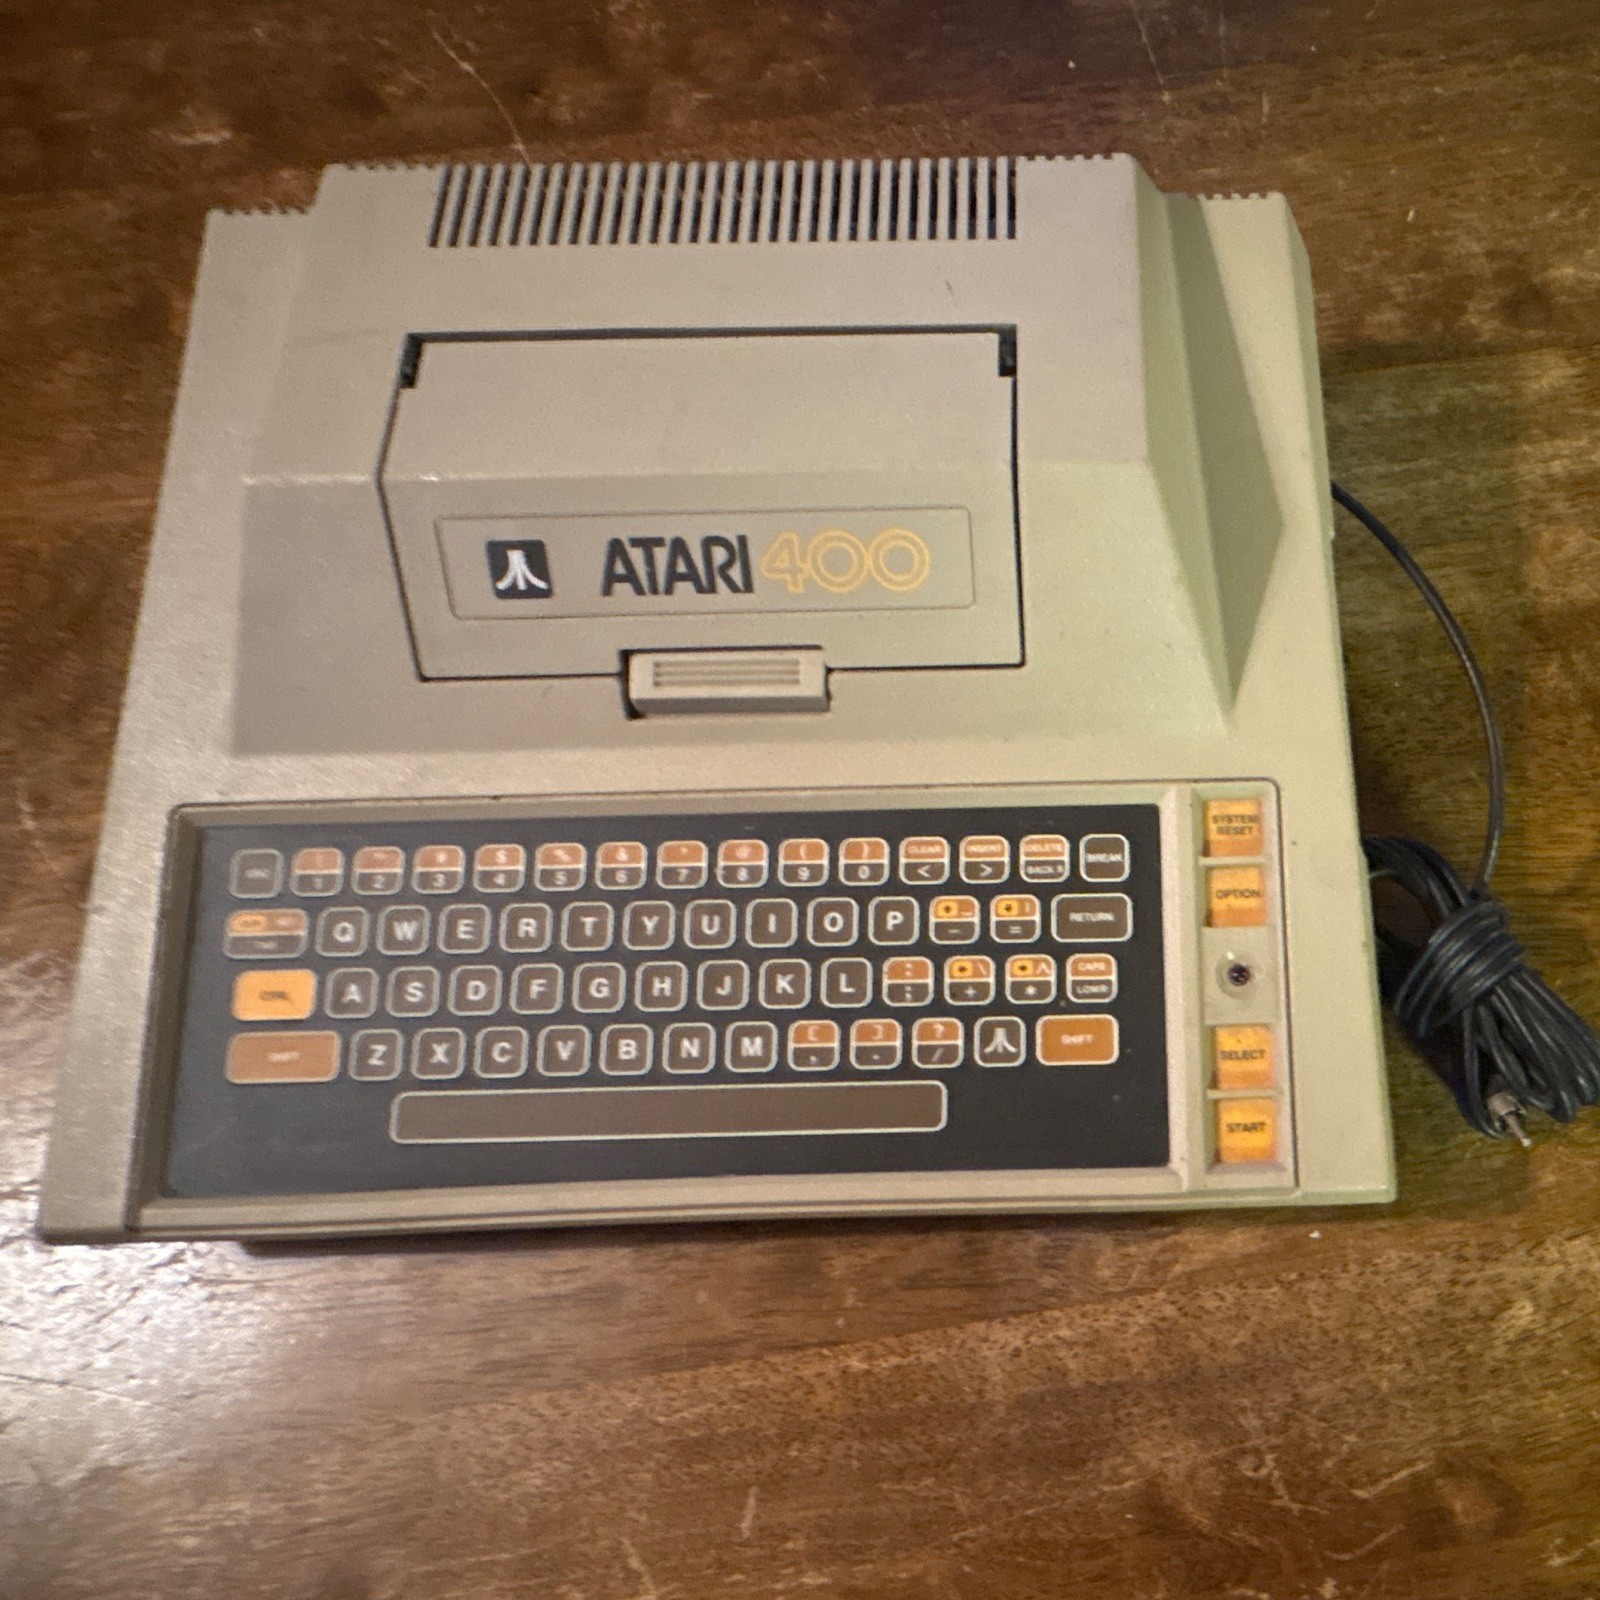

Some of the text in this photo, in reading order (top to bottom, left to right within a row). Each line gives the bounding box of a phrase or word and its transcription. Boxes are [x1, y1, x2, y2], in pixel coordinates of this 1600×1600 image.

[601, 527, 931, 596] ATARI 400
[1216, 825, 1254, 836] RESET
[433, 873, 446, 887] 3
[492, 872, 505, 886] 4
[555, 871, 568, 884] 5
[615, 870, 628, 884] 6
[677, 868, 690, 882] 7
[736, 867, 749, 881] 8
[797, 867, 810, 881] 9
[858, 865, 870, 879] 0
[917, 866, 931, 878] <
[978, 864, 993, 878] >
[372, 875, 384, 889] 2
[1215, 889, 1262, 899] OPTION
[580, 917, 599, 937] T
[641, 915, 660, 936] Y
[701, 914, 721, 935] U
[768, 912, 777, 934] I
[823, 911, 844, 933] O
[886, 911, 904, 931] P
[1069, 911, 1115, 923] RETURN
[332, 921, 355, 943] Q
[391, 921, 420, 941] W
[456, 919, 475, 940] E
[517, 918, 538, 938] R
[404, 982, 425, 1003] S
[466, 980, 488, 1001] D
[529, 978, 547, 999] F
[589, 977, 610, 998] G
[652, 976, 672, 997] H
[716, 975, 732, 996] J
[775, 973, 795, 994] K
[839, 972, 856, 993] L
[964, 984, 977, 998] +
[342, 983, 363, 1003] A
[933, 1024, 945, 1039] ?
[1060, 1033, 1095, 1045] SHIFT
[367, 1044, 388, 1065] Z
[429, 1042, 450, 1064] X
[491, 1042, 512, 1063] C
[555, 1039, 575, 1061] V
[617, 1039, 638, 1060] B
[680, 1037, 700, 1058] N
[740, 1036, 763, 1057] M
[931, 1048, 943, 1062] /
[1219, 1048, 1267, 1061] SELECT
[1226, 1121, 1267, 1134] START
